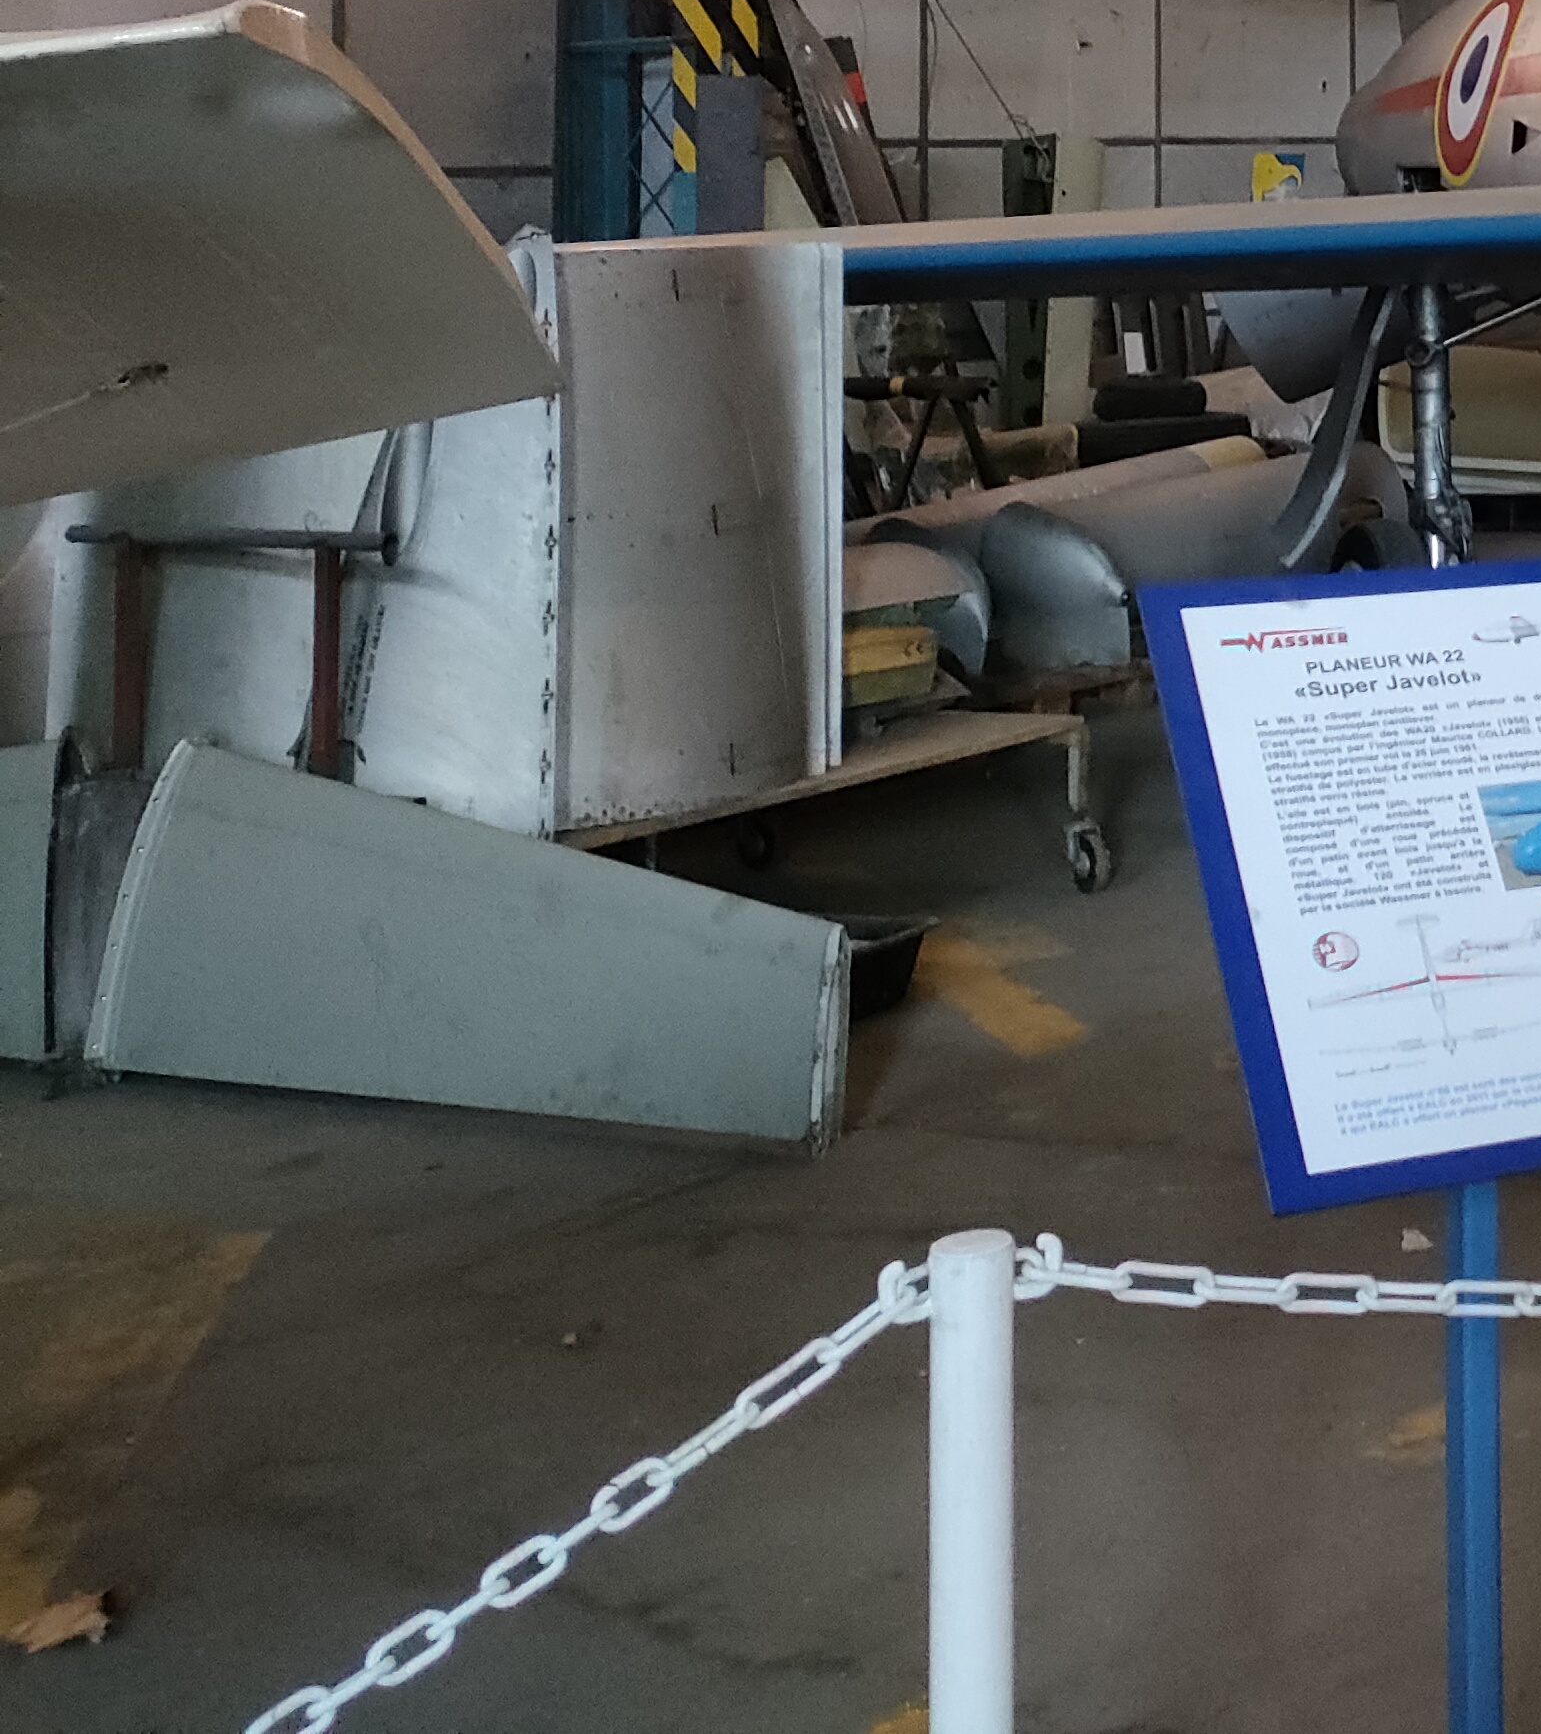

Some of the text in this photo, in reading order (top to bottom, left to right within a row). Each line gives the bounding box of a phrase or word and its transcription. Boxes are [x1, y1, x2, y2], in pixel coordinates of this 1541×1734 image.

[1305, 648, 1466, 675] PLANEUR WA 22
[1294, 669, 1482, 700] «Super Javelot»
